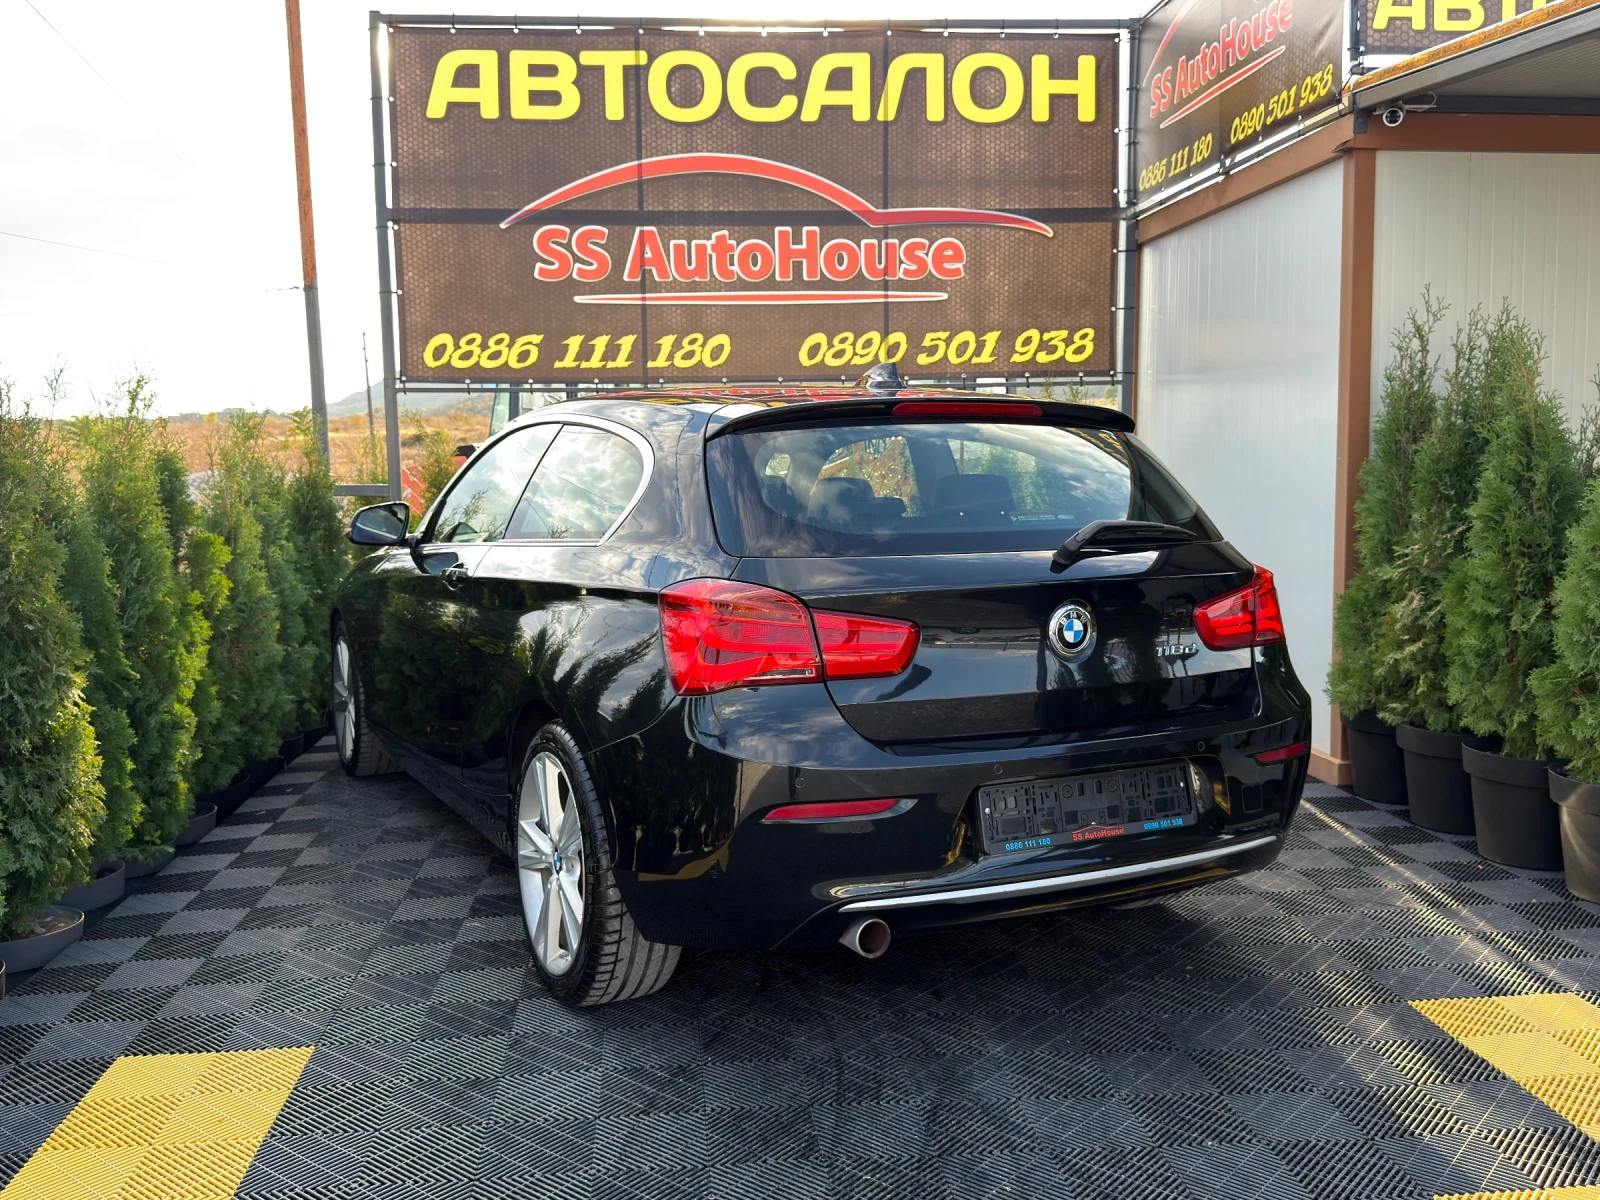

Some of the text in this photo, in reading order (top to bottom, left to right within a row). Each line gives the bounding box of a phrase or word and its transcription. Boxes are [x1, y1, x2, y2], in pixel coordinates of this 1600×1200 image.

[1150, 0, 1294, 119] SS AutoHouse
[425, 49, 1097, 124] АВТОСАЛОН
[1230, 63, 1334, 145] 0890 501 938
[1139, 132, 1213, 191] 0886 111 180
[533, 225, 966, 283] SS AutoHouse
[422, 332, 733, 370] 0886 111 180
[798, 327, 1095, 368] 0890 501 938
[1005, 841, 1023, 851] 0886
[1025, 839, 1036, 848] 111
[1072, 828, 1124, 841] SS AutoHouse
[1160, 819, 1170, 829] 501
